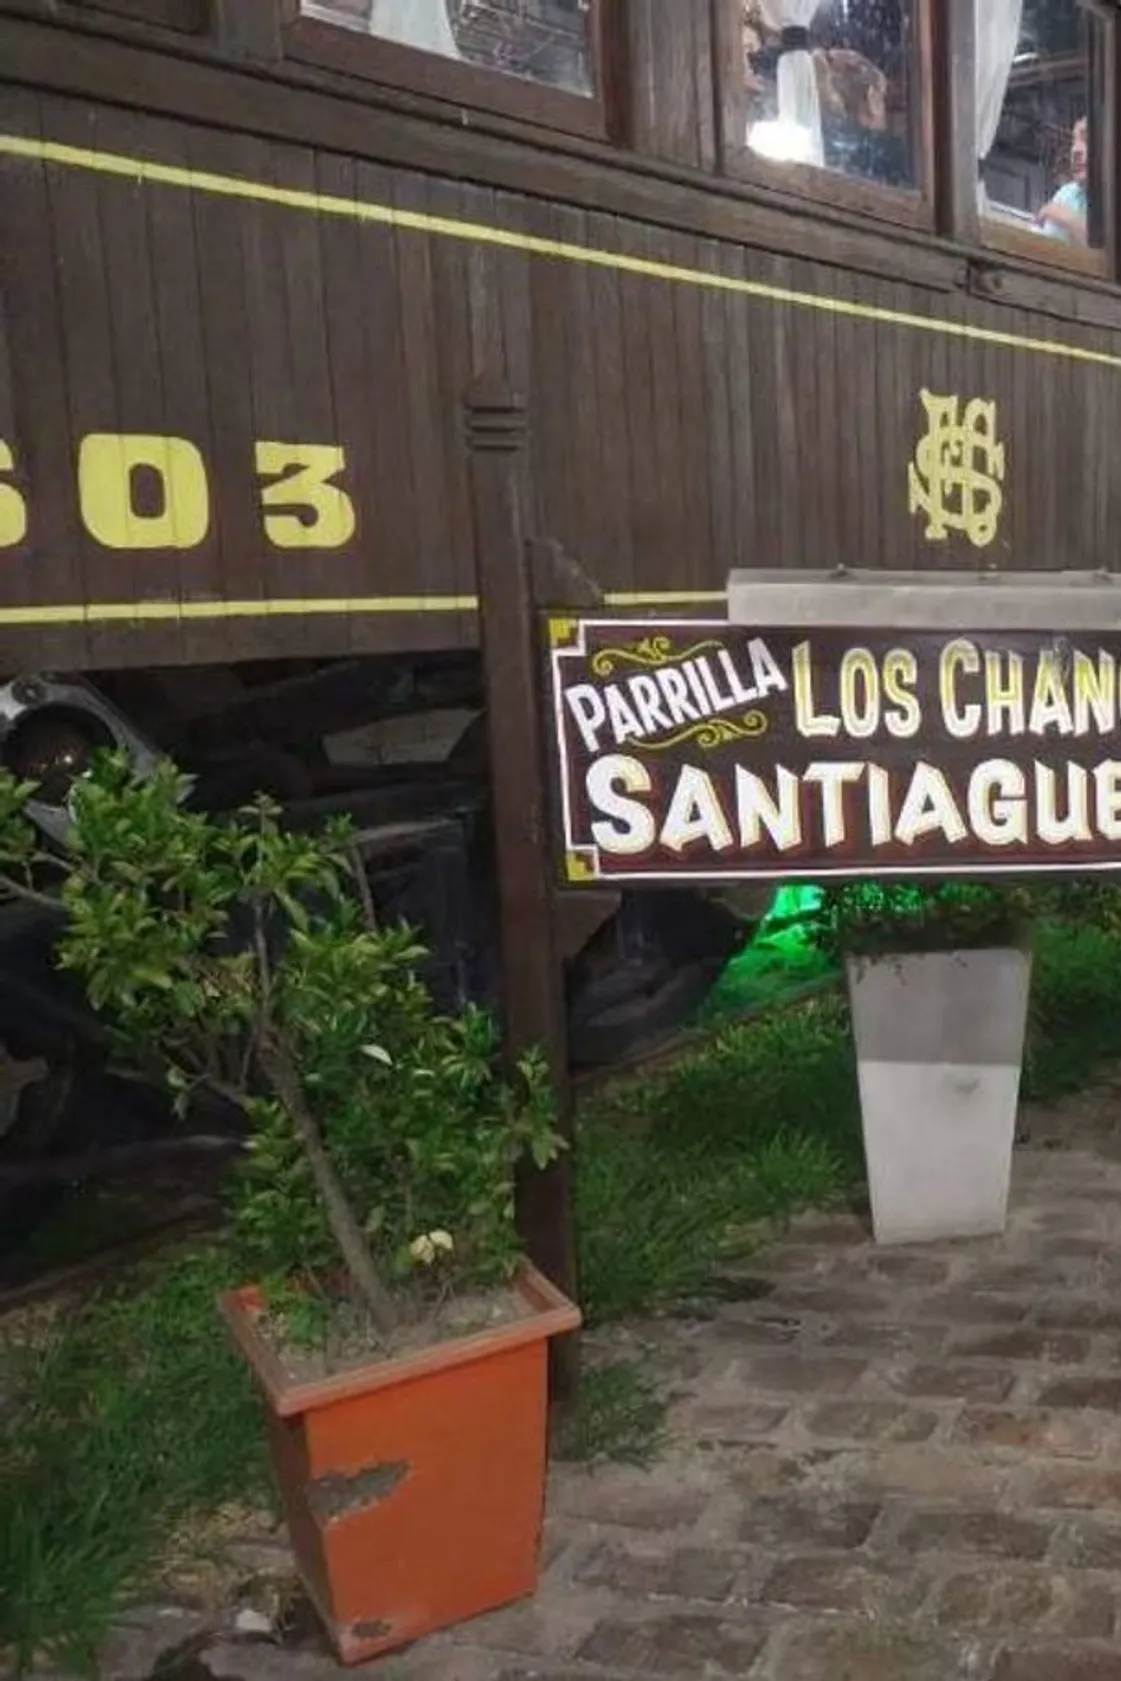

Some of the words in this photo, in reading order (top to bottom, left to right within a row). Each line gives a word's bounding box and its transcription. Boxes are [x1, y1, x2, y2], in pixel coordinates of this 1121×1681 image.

[0, 433, 355, 548] 03
[565, 637, 788, 752] PARRILLA
[793, 640, 922, 738] LOS
